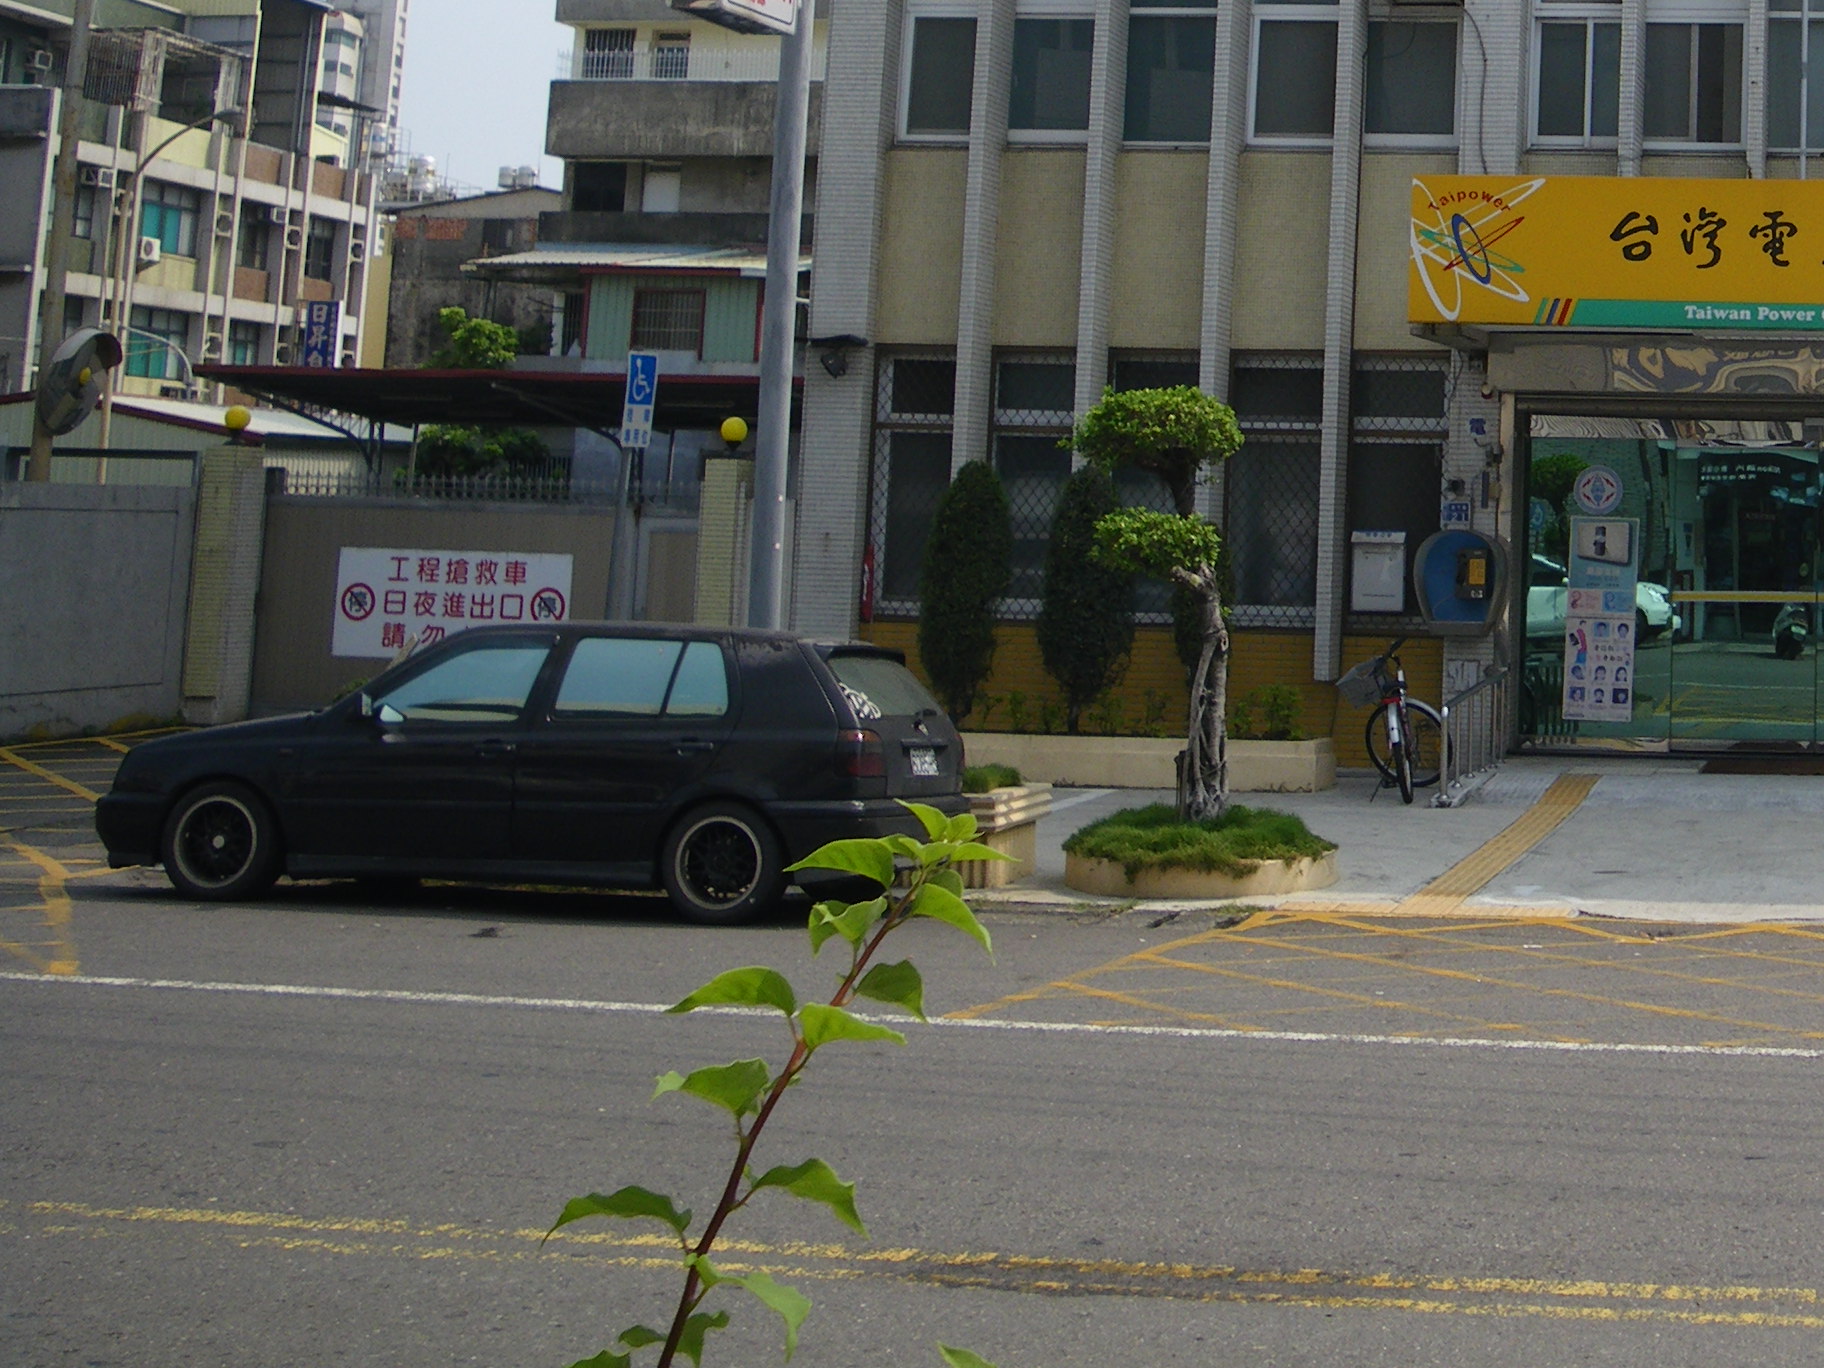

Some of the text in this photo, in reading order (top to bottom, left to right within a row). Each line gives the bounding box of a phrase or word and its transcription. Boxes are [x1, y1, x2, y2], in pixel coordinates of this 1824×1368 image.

[1427, 190, 1511, 211] Taipower
[1684, 305, 1751, 321] Taiwan
[1757, 306, 1816, 322] Power
[387, 556, 528, 586] 工程搶救車
[383, 589, 525, 621] 日夜進出口
[381, 622, 474, 650] 請勿
